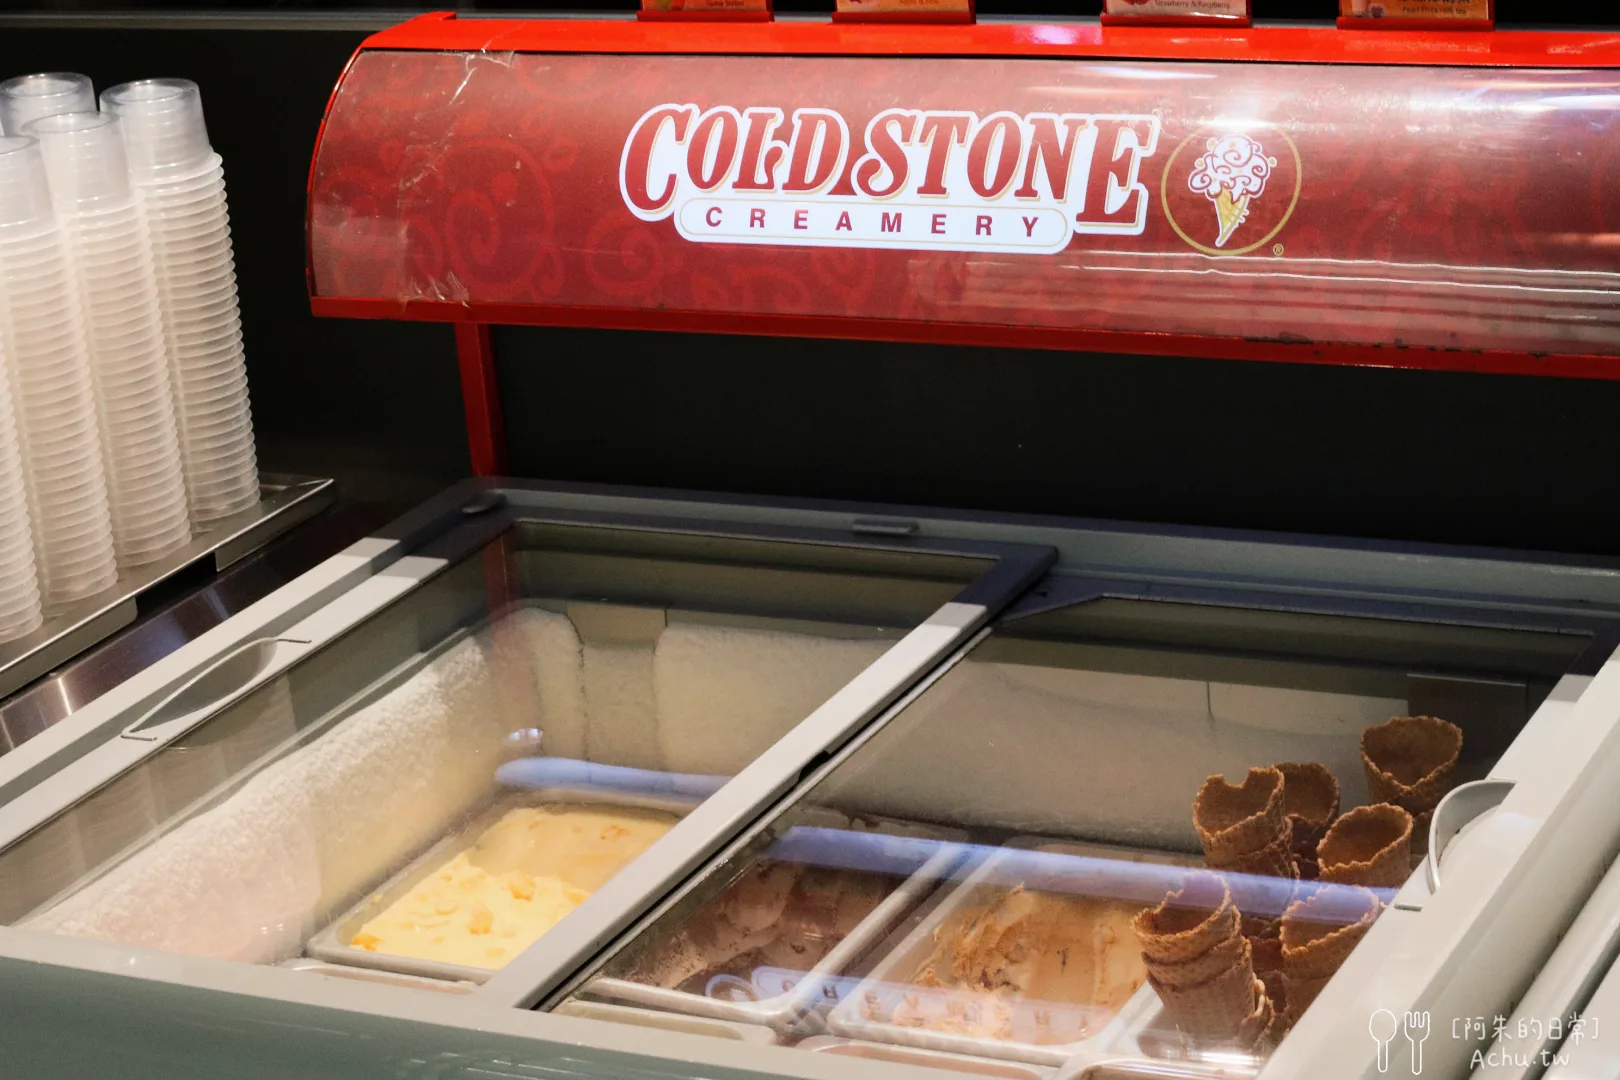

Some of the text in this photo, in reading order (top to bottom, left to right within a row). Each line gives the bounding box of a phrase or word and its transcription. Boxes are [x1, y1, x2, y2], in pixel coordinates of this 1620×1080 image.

[624, 107, 1153, 228] COLD STONE
[705, 206, 1040, 238] CREAMERY
